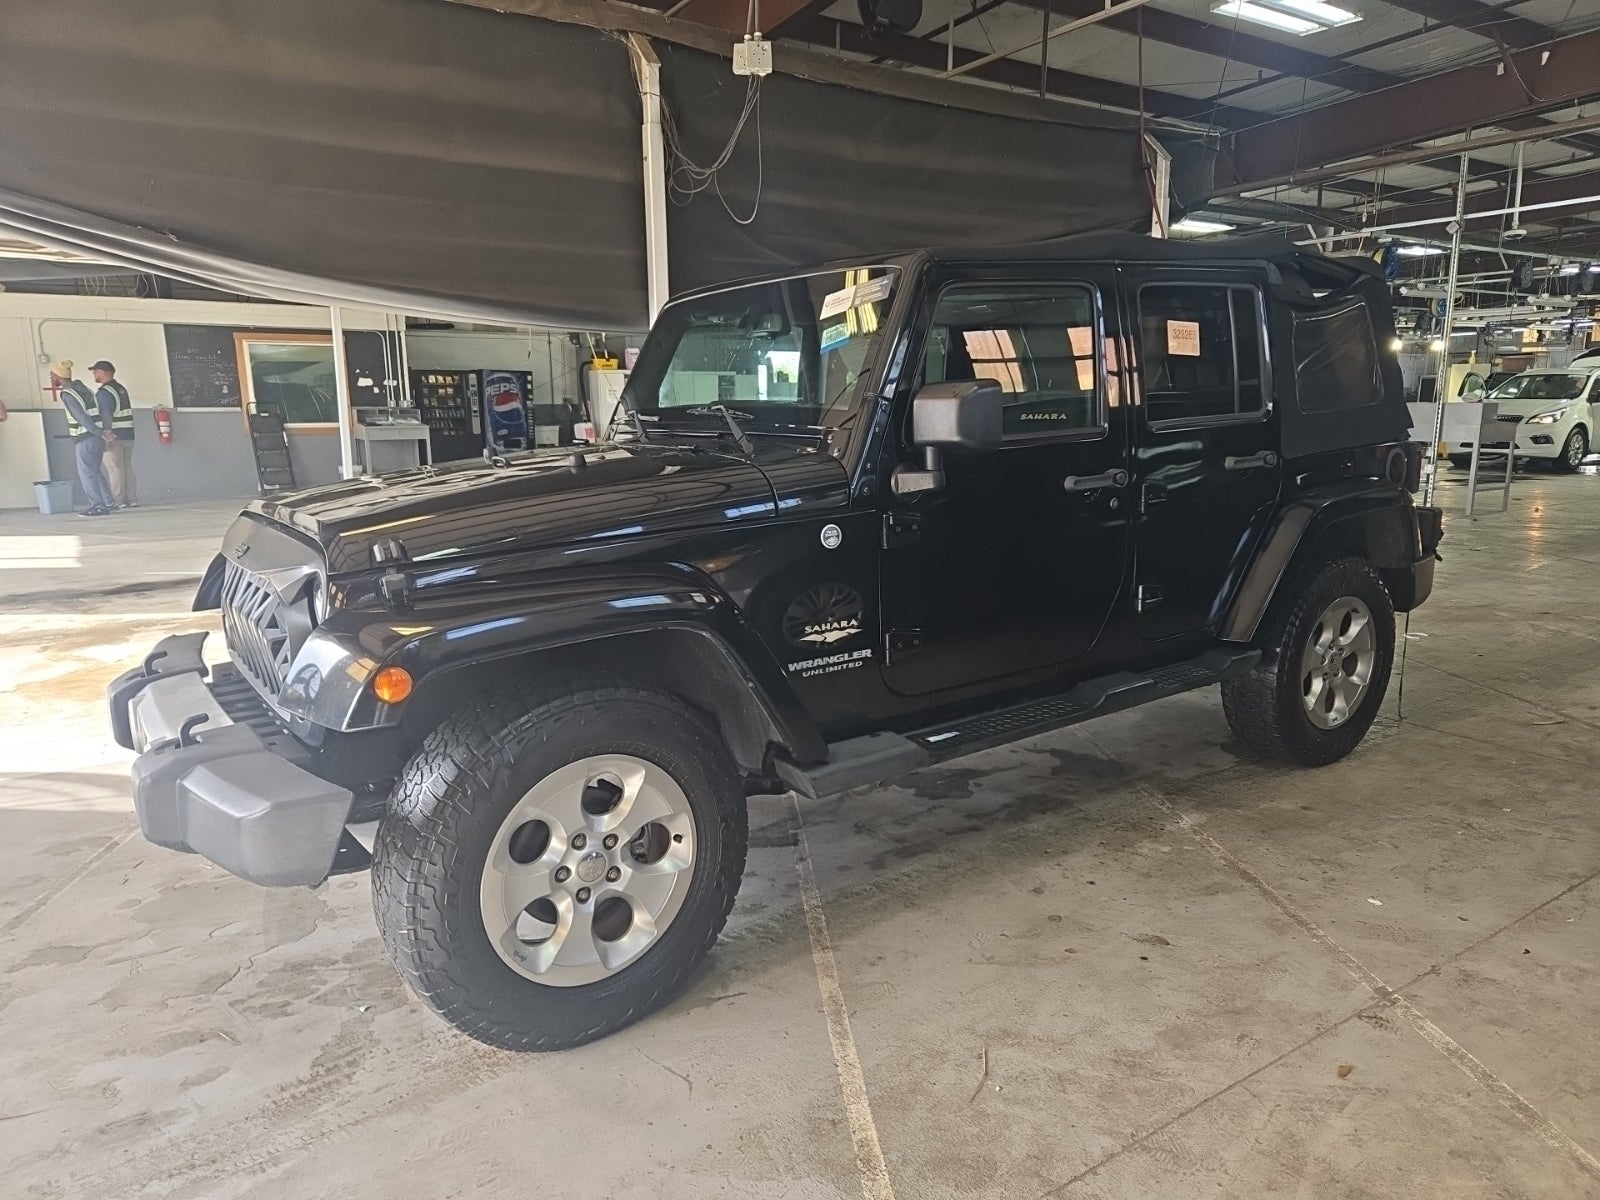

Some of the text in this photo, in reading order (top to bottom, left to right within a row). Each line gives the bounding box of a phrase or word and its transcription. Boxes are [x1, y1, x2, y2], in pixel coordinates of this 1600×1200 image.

[804, 618, 859, 634] SAHARA
[788, 648, 873, 672] WRANGLER
[802, 660, 863, 677] UNLIMITED
